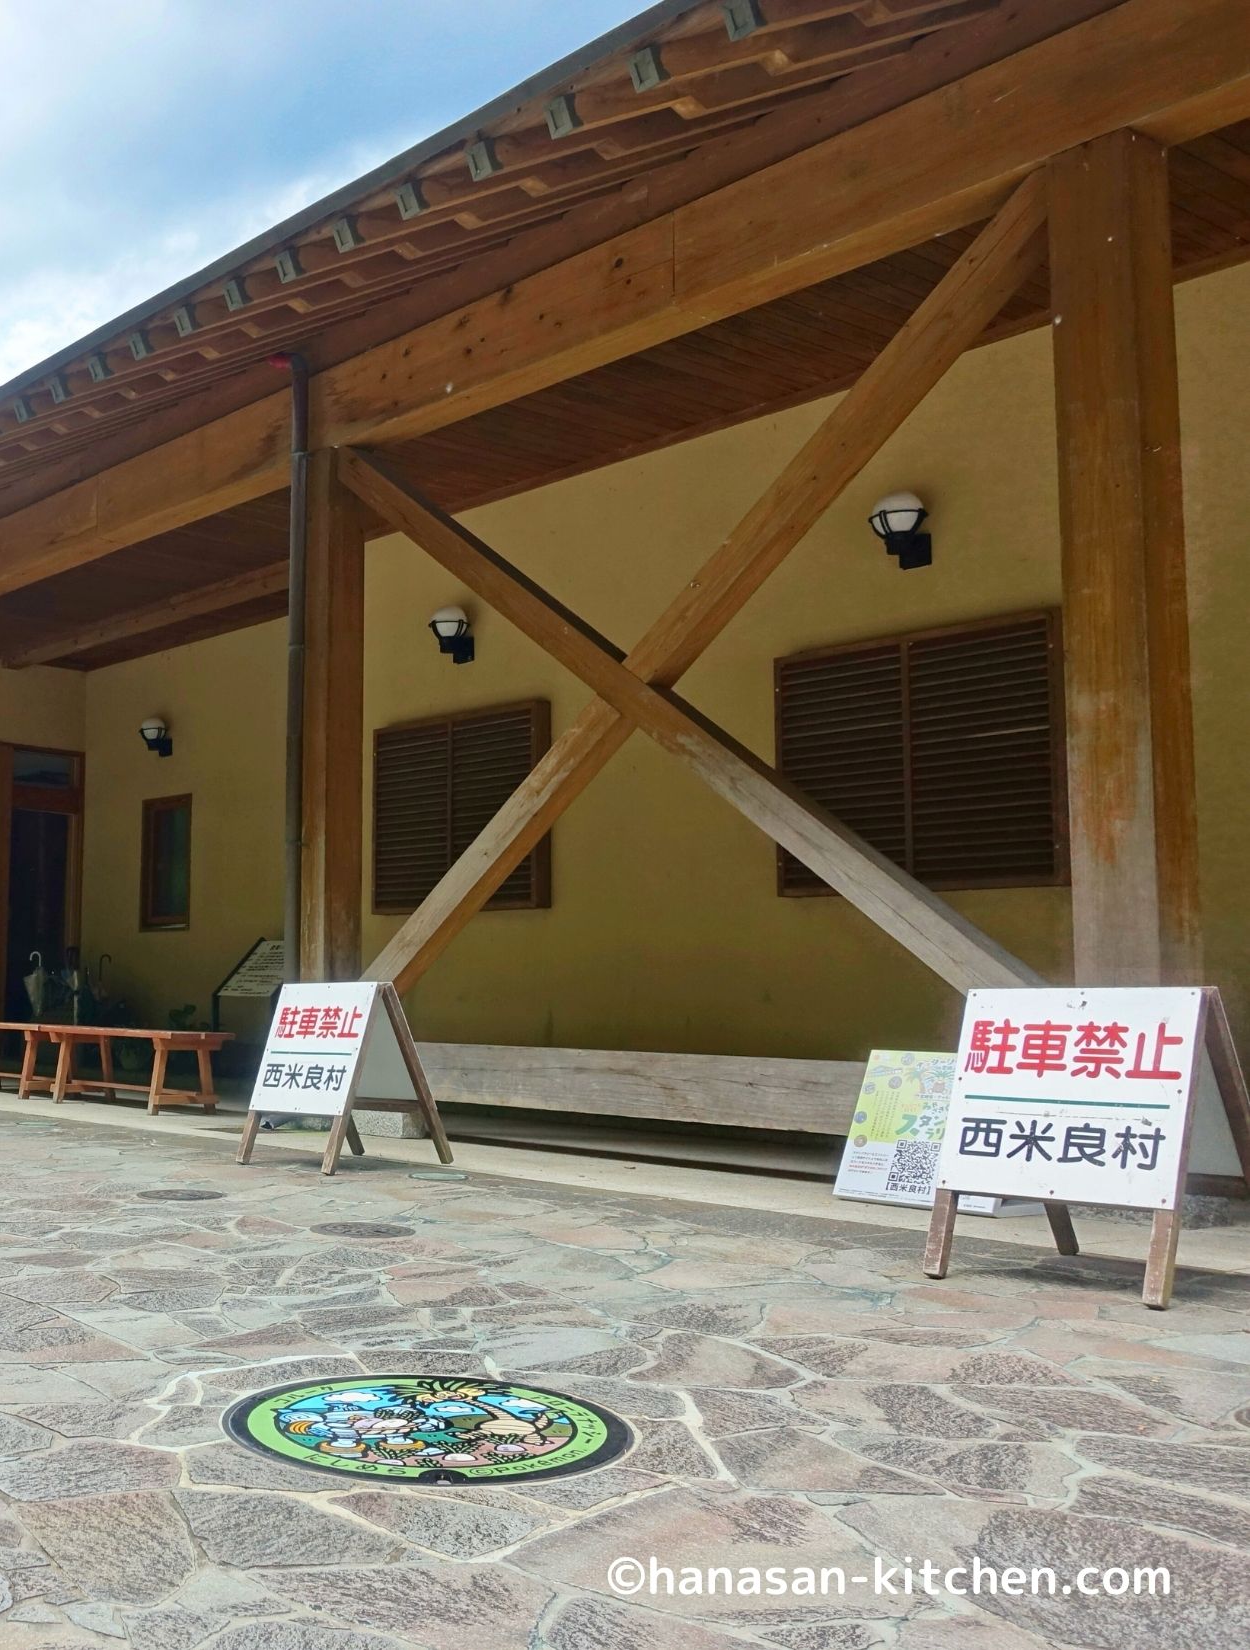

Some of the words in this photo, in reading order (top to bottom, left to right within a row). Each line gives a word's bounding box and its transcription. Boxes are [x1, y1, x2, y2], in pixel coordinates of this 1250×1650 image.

[275, 1006, 363, 1039] 駐車禁止
[964, 1018, 1183, 1081] 駐車禁止
[263, 1063, 346, 1091] 西米良村
[958, 1117, 1166, 1171] 西米良村
[303, 1453, 406, 1475] にしめら
